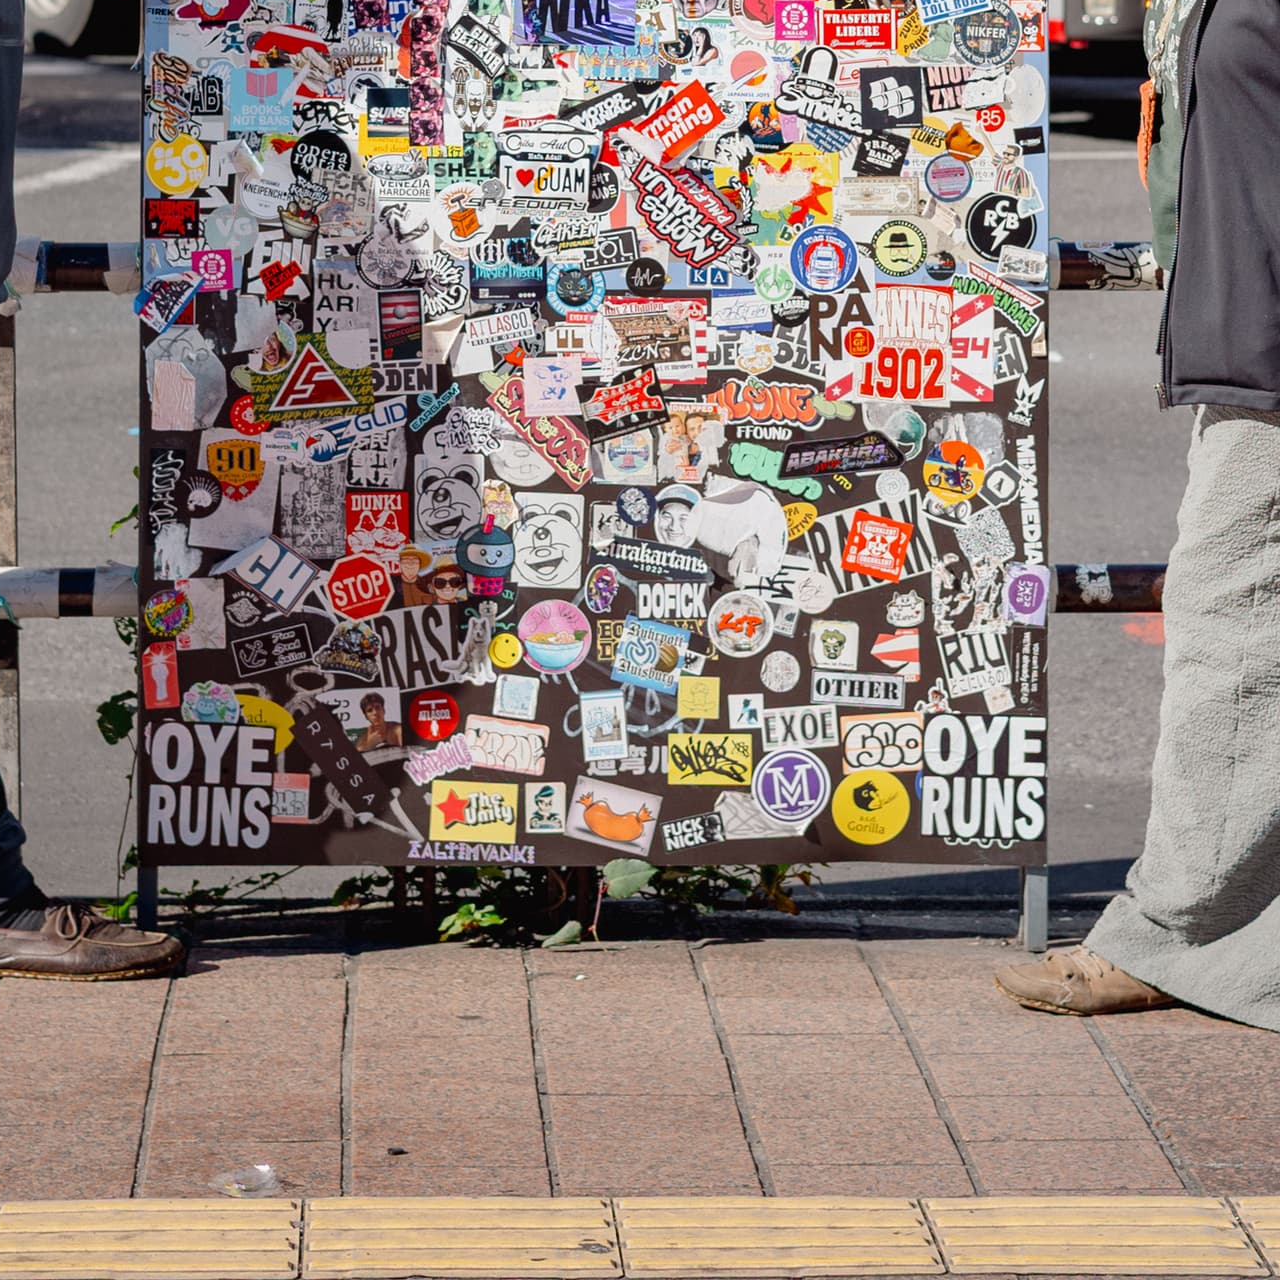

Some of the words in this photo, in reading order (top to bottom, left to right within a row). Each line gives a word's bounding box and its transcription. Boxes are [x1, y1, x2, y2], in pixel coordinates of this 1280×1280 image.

[825, 13, 891, 25] TRASFERTE
[922, 0, 952, 16] TOLL
[781, 29, 808, 37] ANALOG
[835, 25, 881, 38] LIBERE
[965, 25, 1007, 40] NIKFER
[232, 115, 256, 125] NOT
[259, 114, 291, 125] BANS
[241, 104, 282, 115] BOOKS
[979, 109, 1002, 127] 85
[537, 164, 587, 193] GUAM
[378, 187, 431, 197] HARDCORE
[469, 314, 529, 339] ATLASCO
[859, 346, 945, 401] 1902
[410, 387, 458, 432] EARGASM
[735, 427, 793, 441] FFOUND
[788, 444, 888, 472] ABAKURA
[351, 494, 403, 512] DUNK1
[331, 573, 385, 607] STOP
[638, 582, 708, 620] DOFICK
[815, 677, 900, 701] OTHER
[764, 709, 835, 745] EXOE
[150, 720, 275, 786] OYE
[923, 713, 1047, 778] OYE
[467, 791, 506, 809] The
[921, 775, 1046, 841] RUNS
[146, 783, 271, 850] RUNS
[465, 802, 516, 825] Unity
[662, 817, 704, 840] FUCK
[846, 820, 886, 835] Gorilla
[665, 831, 708, 852] NICK
